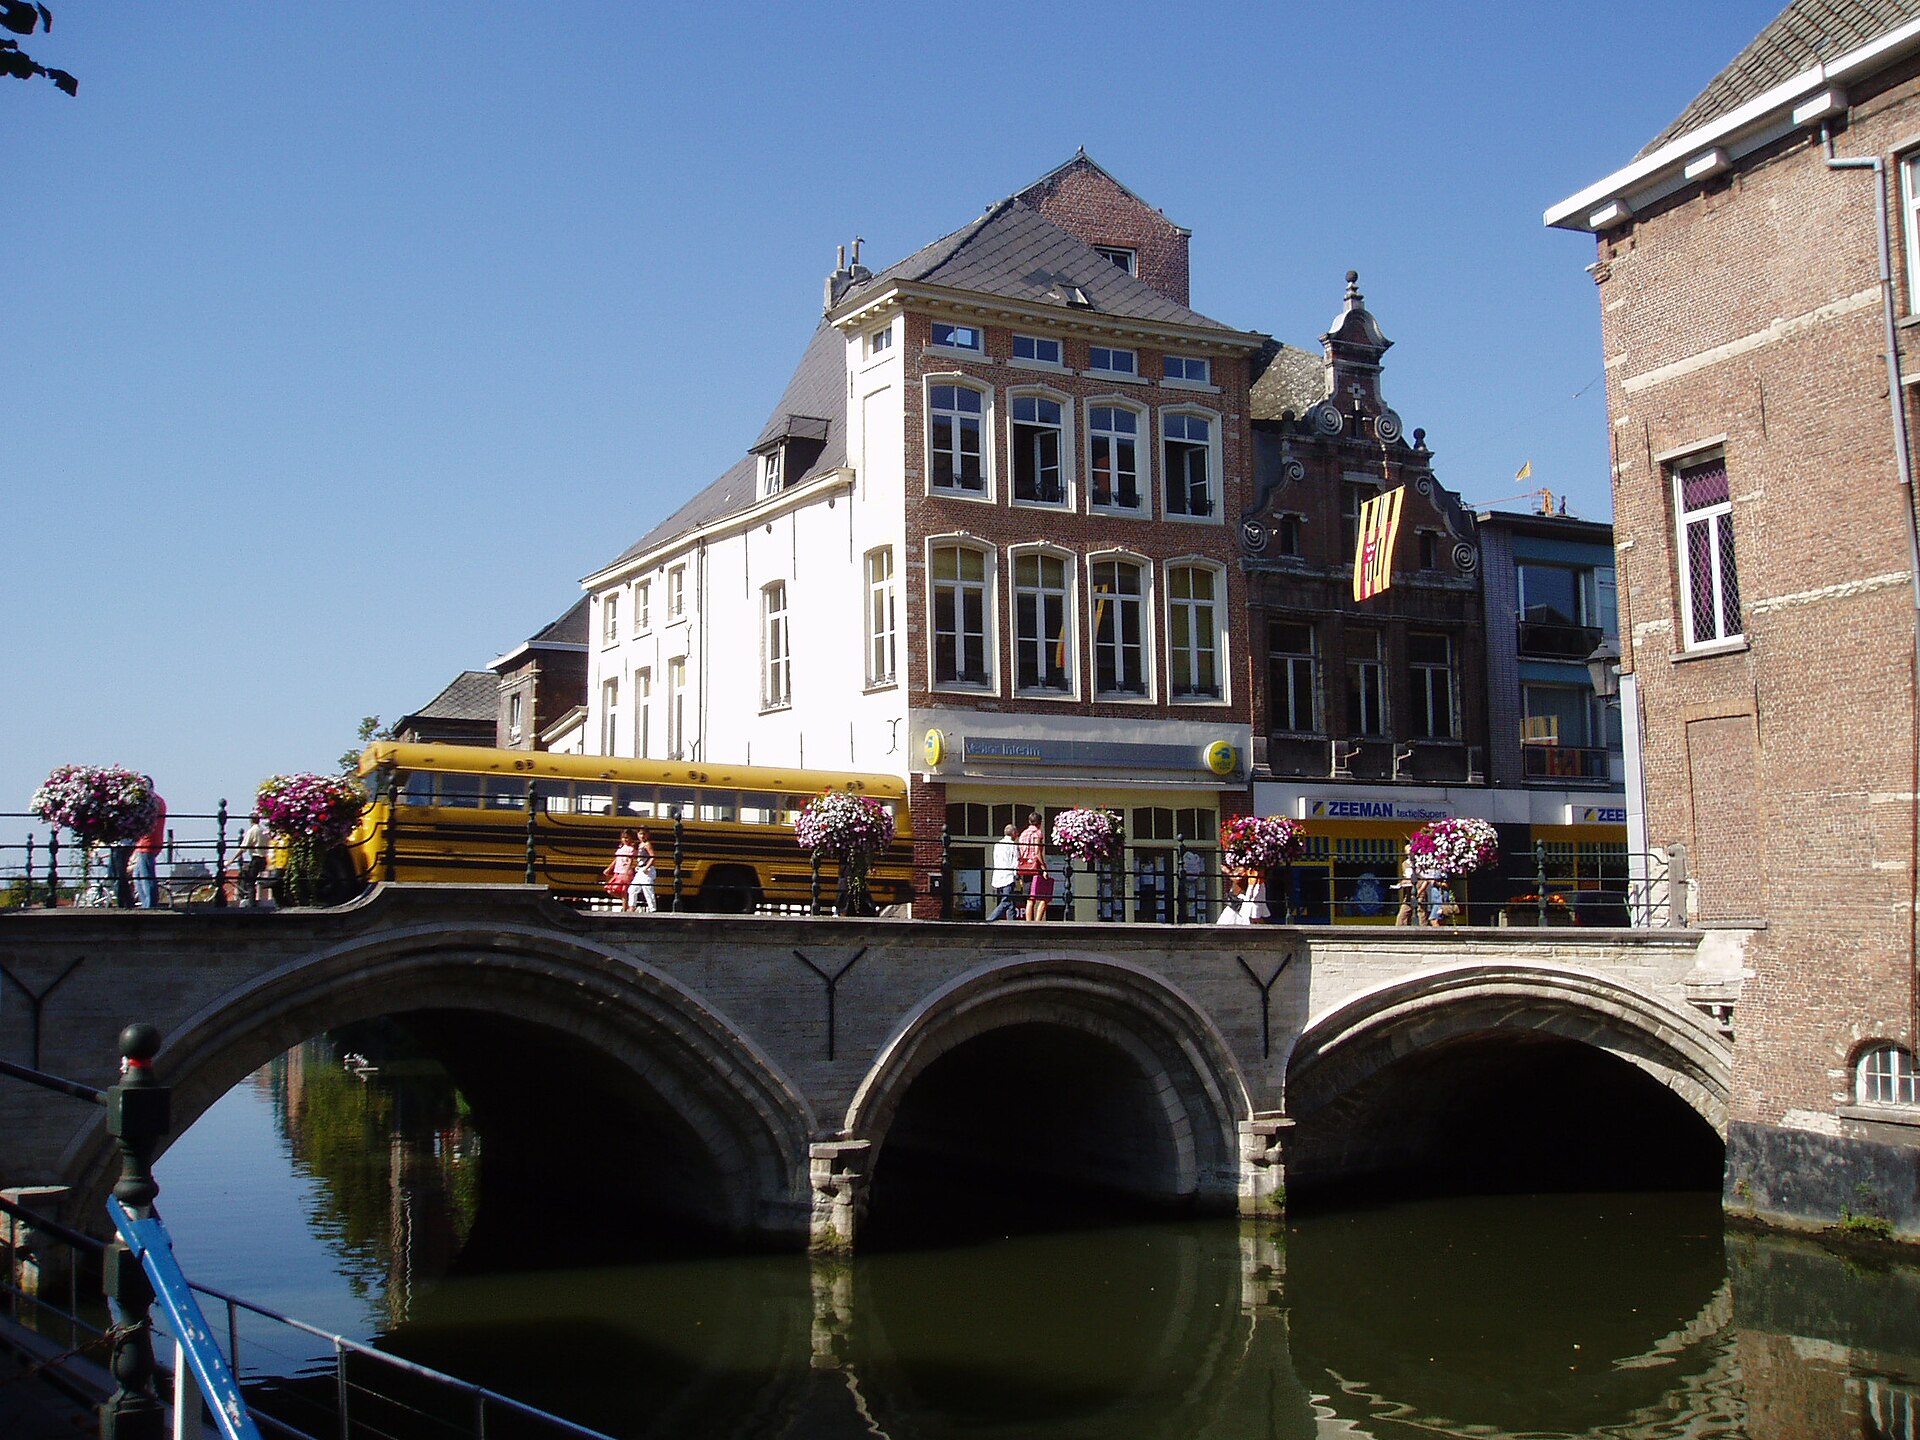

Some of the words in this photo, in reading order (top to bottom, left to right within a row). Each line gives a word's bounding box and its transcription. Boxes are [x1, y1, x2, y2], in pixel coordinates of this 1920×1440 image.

[1002, 743, 1040, 756] Interim
[1328, 801, 1393, 818] ZEEMAN
[1598, 808, 1627, 821] ZEE
